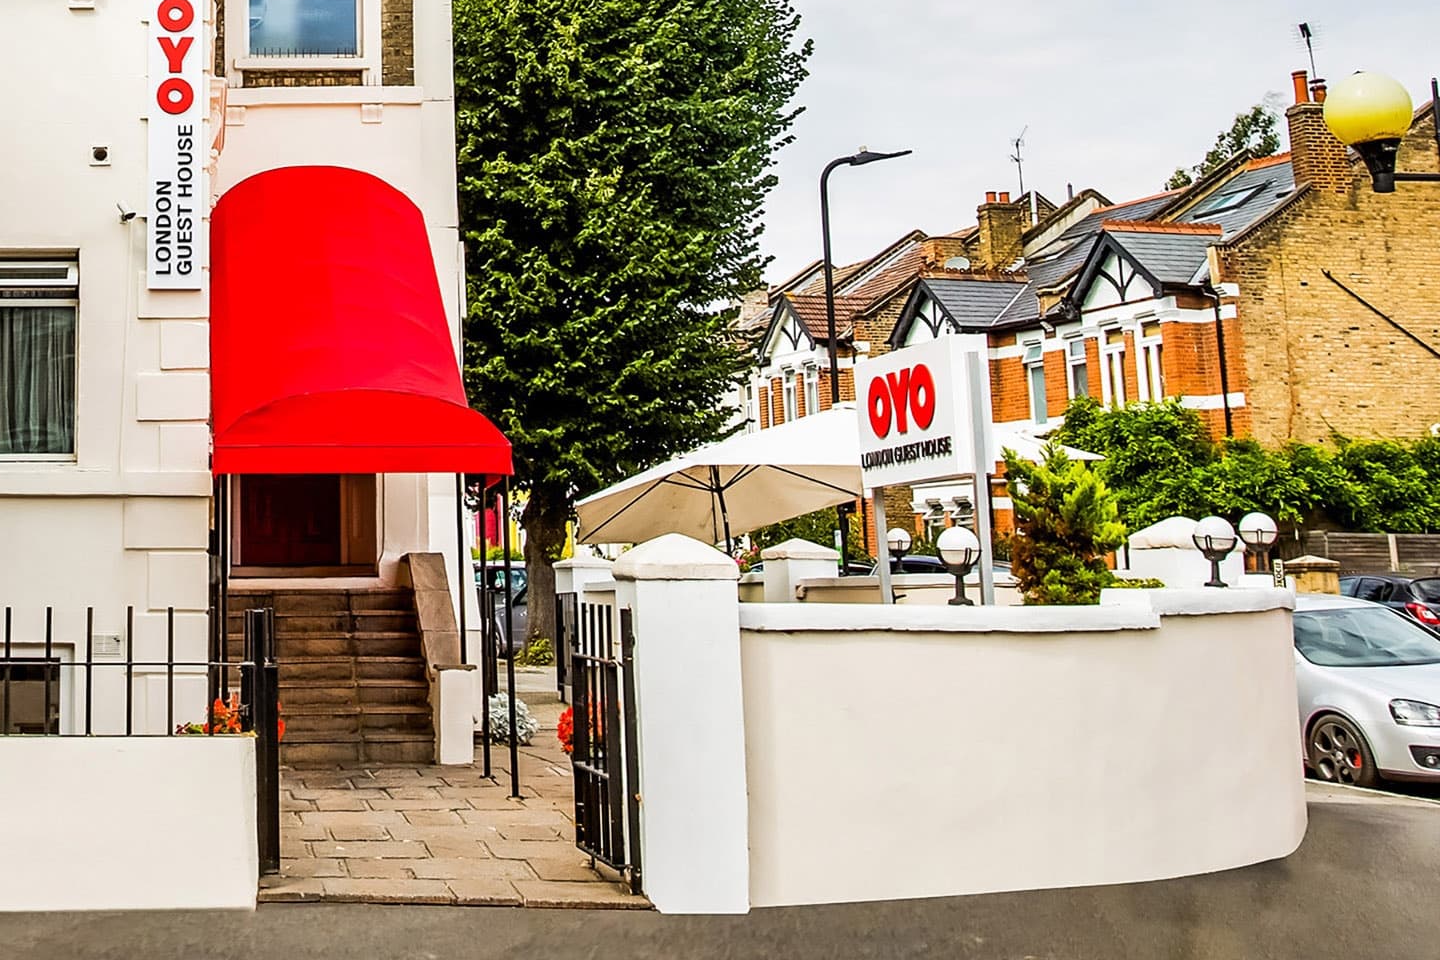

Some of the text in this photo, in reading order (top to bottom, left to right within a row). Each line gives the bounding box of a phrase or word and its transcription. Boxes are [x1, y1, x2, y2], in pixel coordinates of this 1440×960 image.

[155, 180, 172, 276] LONDON
[176, 124, 193, 276] GUEST HOUSE
[868, 363, 936, 440] OYO
[861, 436, 952, 471] LONDON GUEST HOUSE
